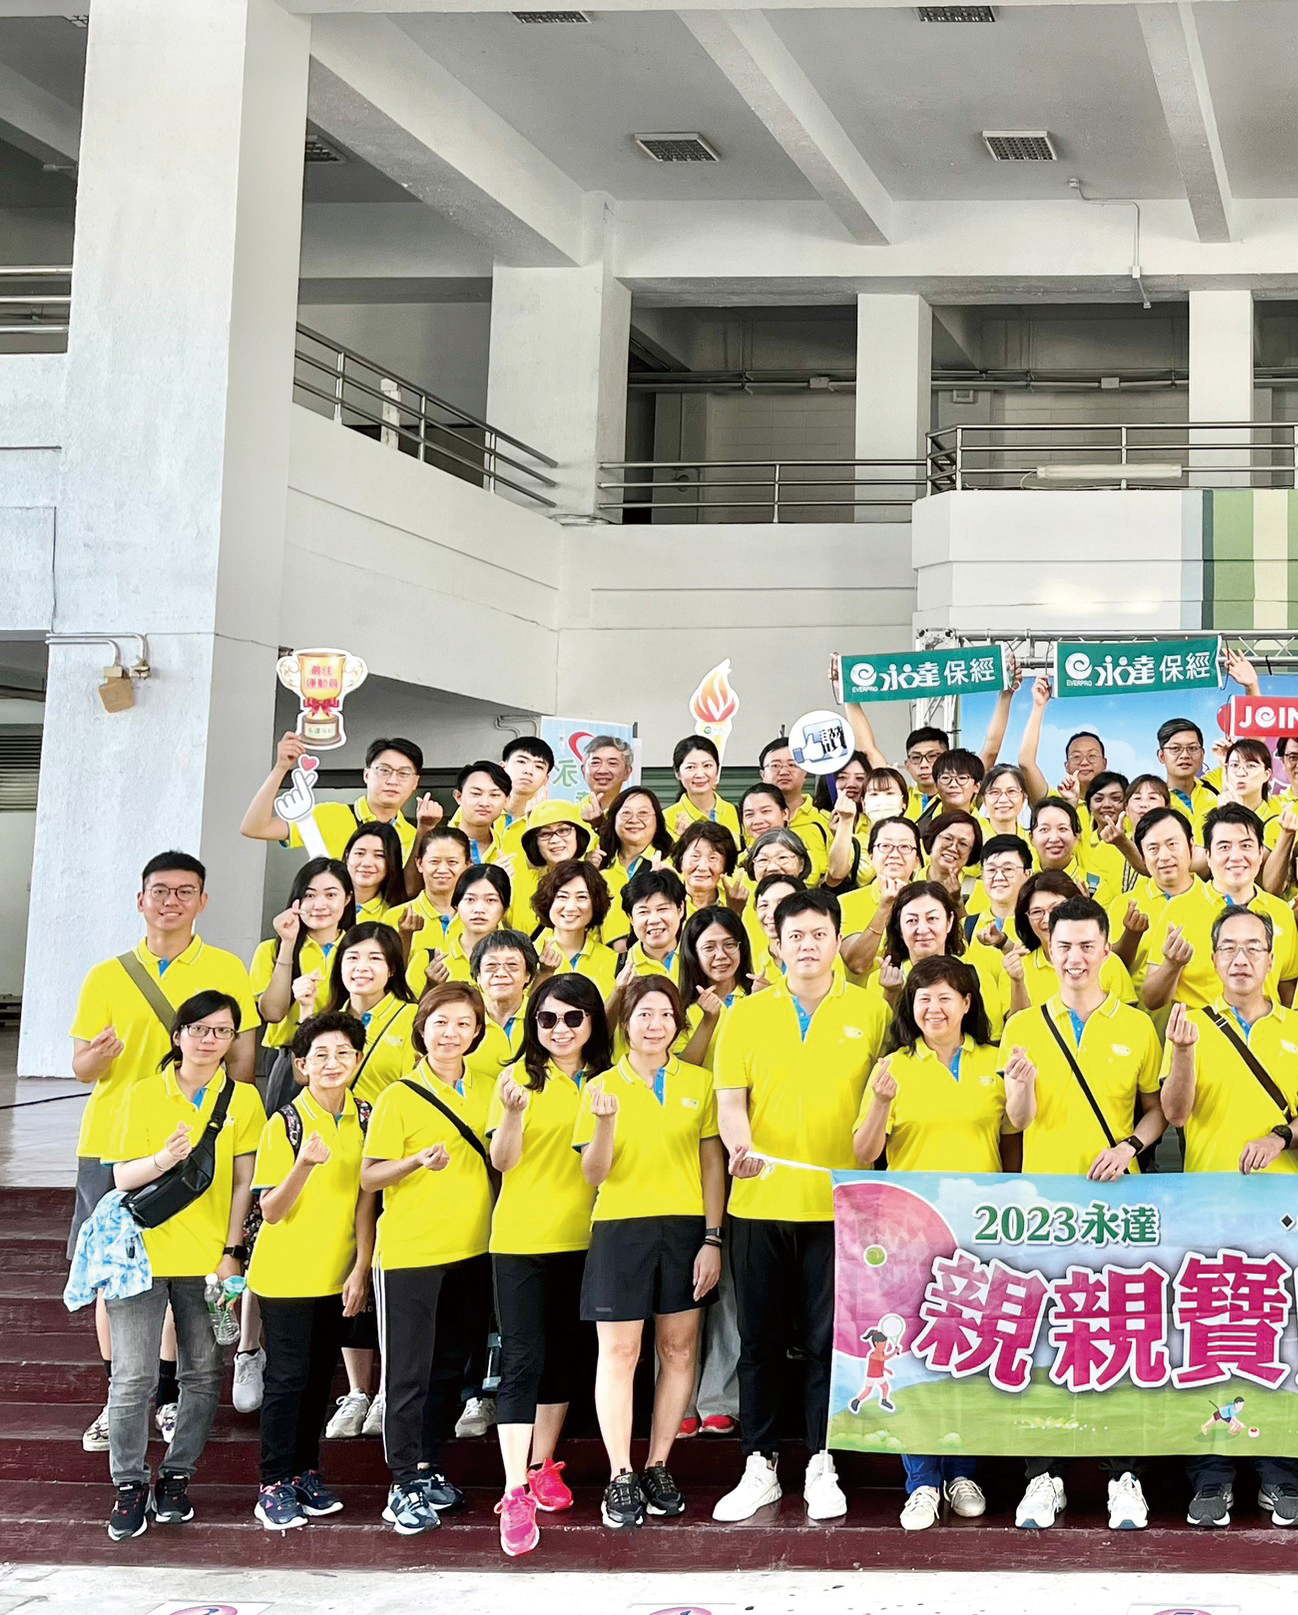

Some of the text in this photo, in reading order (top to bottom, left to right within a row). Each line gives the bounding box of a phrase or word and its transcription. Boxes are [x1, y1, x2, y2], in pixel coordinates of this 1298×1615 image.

[1066, 679, 1093, 687] EVERPRO
[851, 685, 879, 694] EVERPRO
[973, 1203, 1158, 1246] 2023永達
